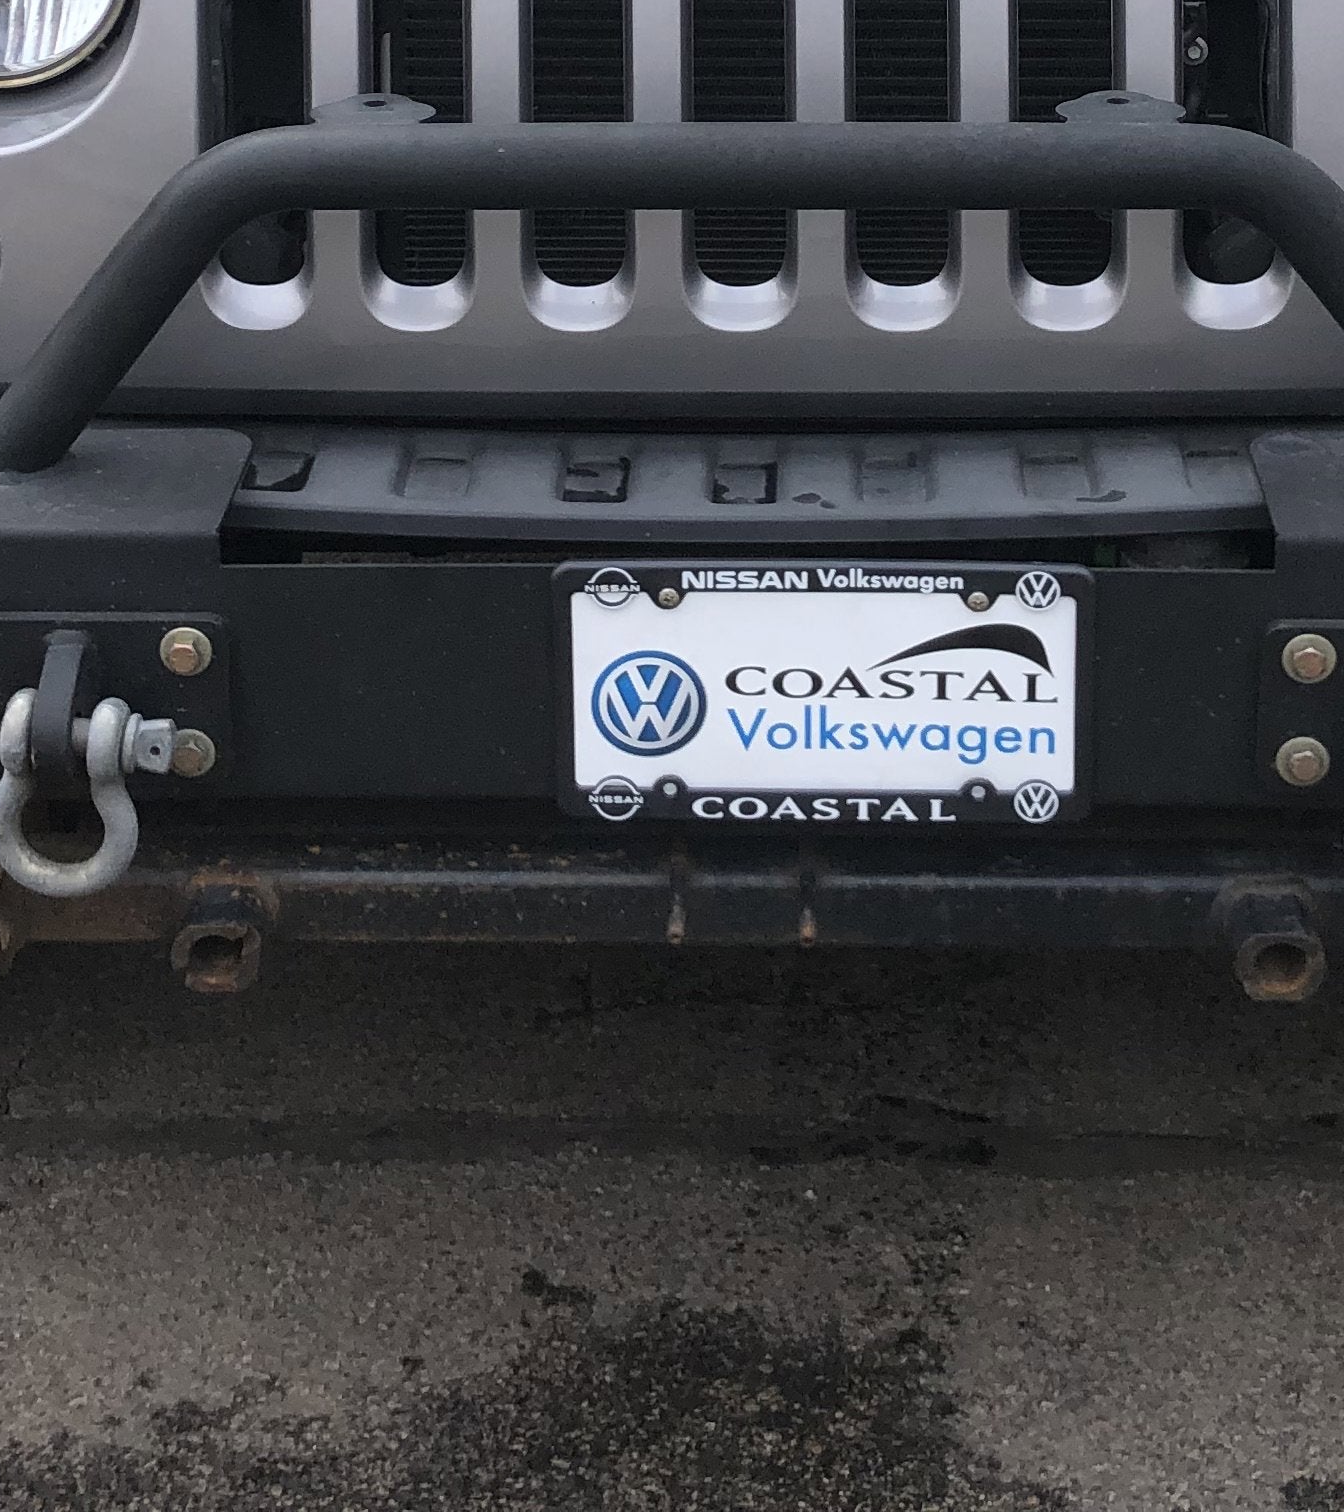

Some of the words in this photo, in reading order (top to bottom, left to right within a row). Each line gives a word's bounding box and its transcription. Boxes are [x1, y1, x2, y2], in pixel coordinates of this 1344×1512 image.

[681, 569, 809, 590] NISSAN
[816, 568, 965, 593] Volkswagen
[724, 666, 1059, 704] COASTAL
[726, 704, 1057, 764] Volkswagen
[691, 796, 957, 822] COASTAL
